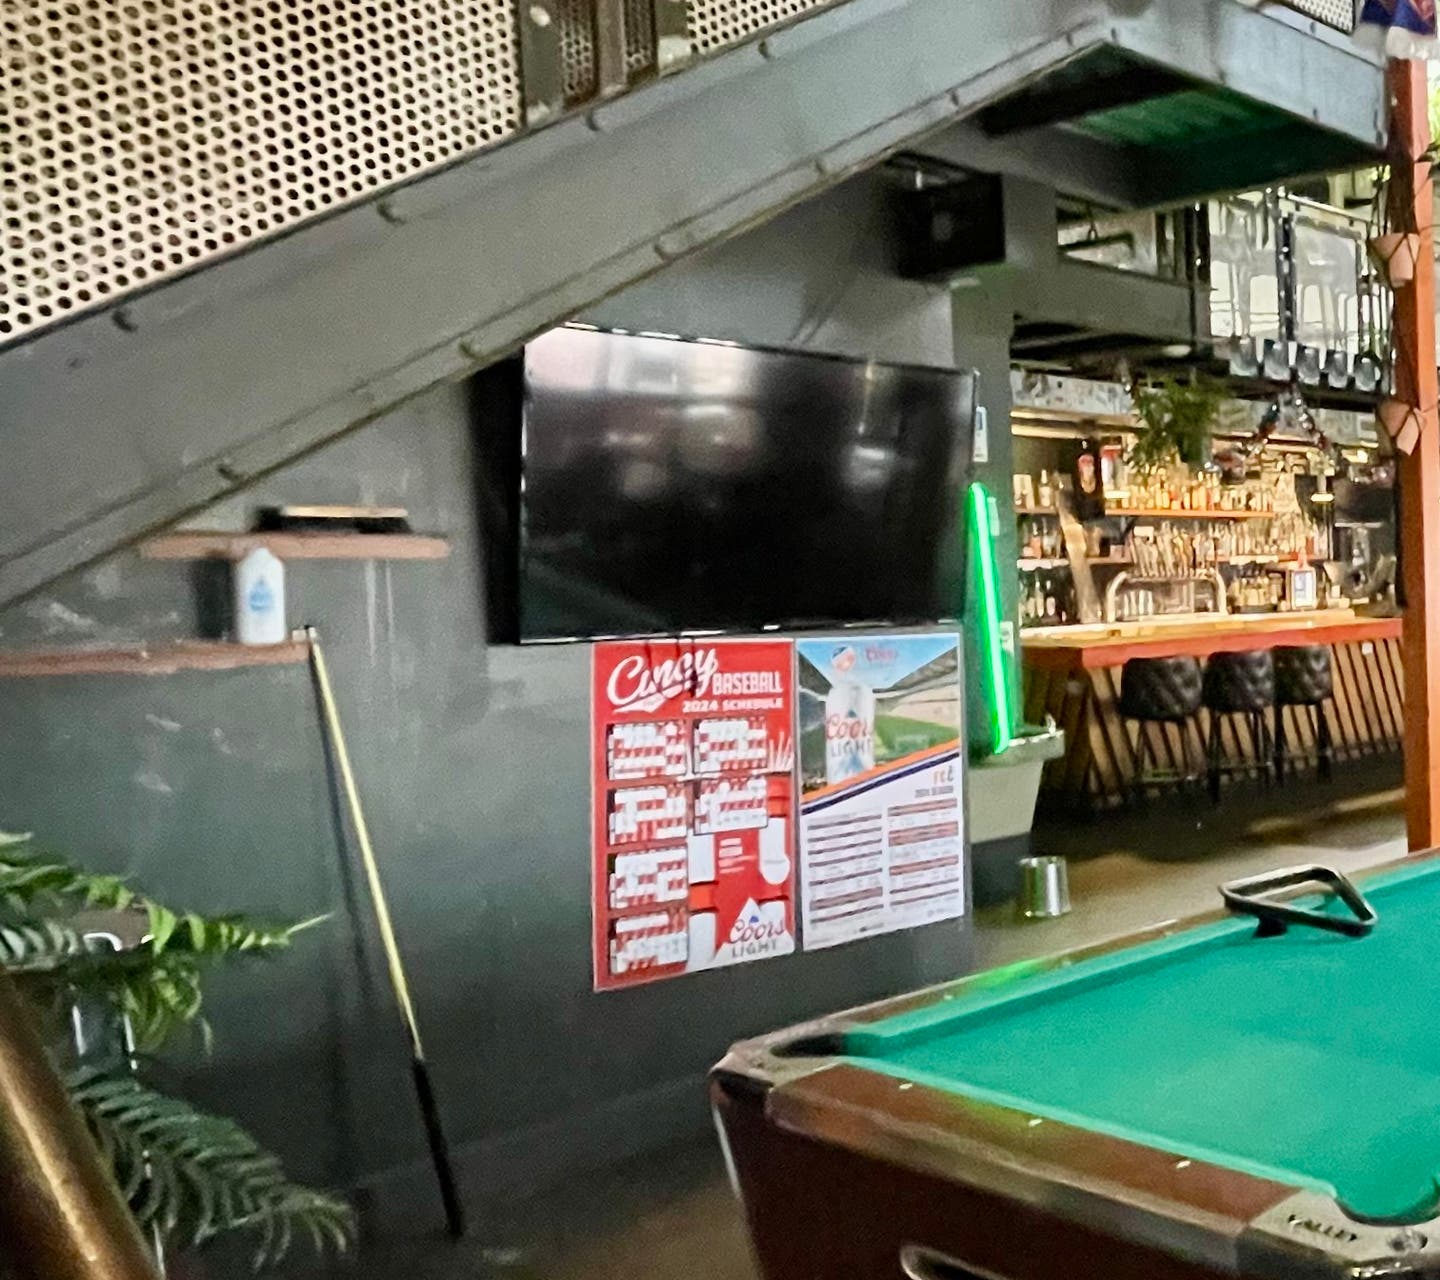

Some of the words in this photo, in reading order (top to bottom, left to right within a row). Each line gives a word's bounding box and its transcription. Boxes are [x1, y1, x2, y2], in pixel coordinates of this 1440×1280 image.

[607, 648, 719, 708] Cincy
[712, 671, 784, 696] BASEBALL
[682, 700, 719, 713] 2024
[729, 919, 785, 944] Coors
[731, 939, 777, 958] LIGHT
